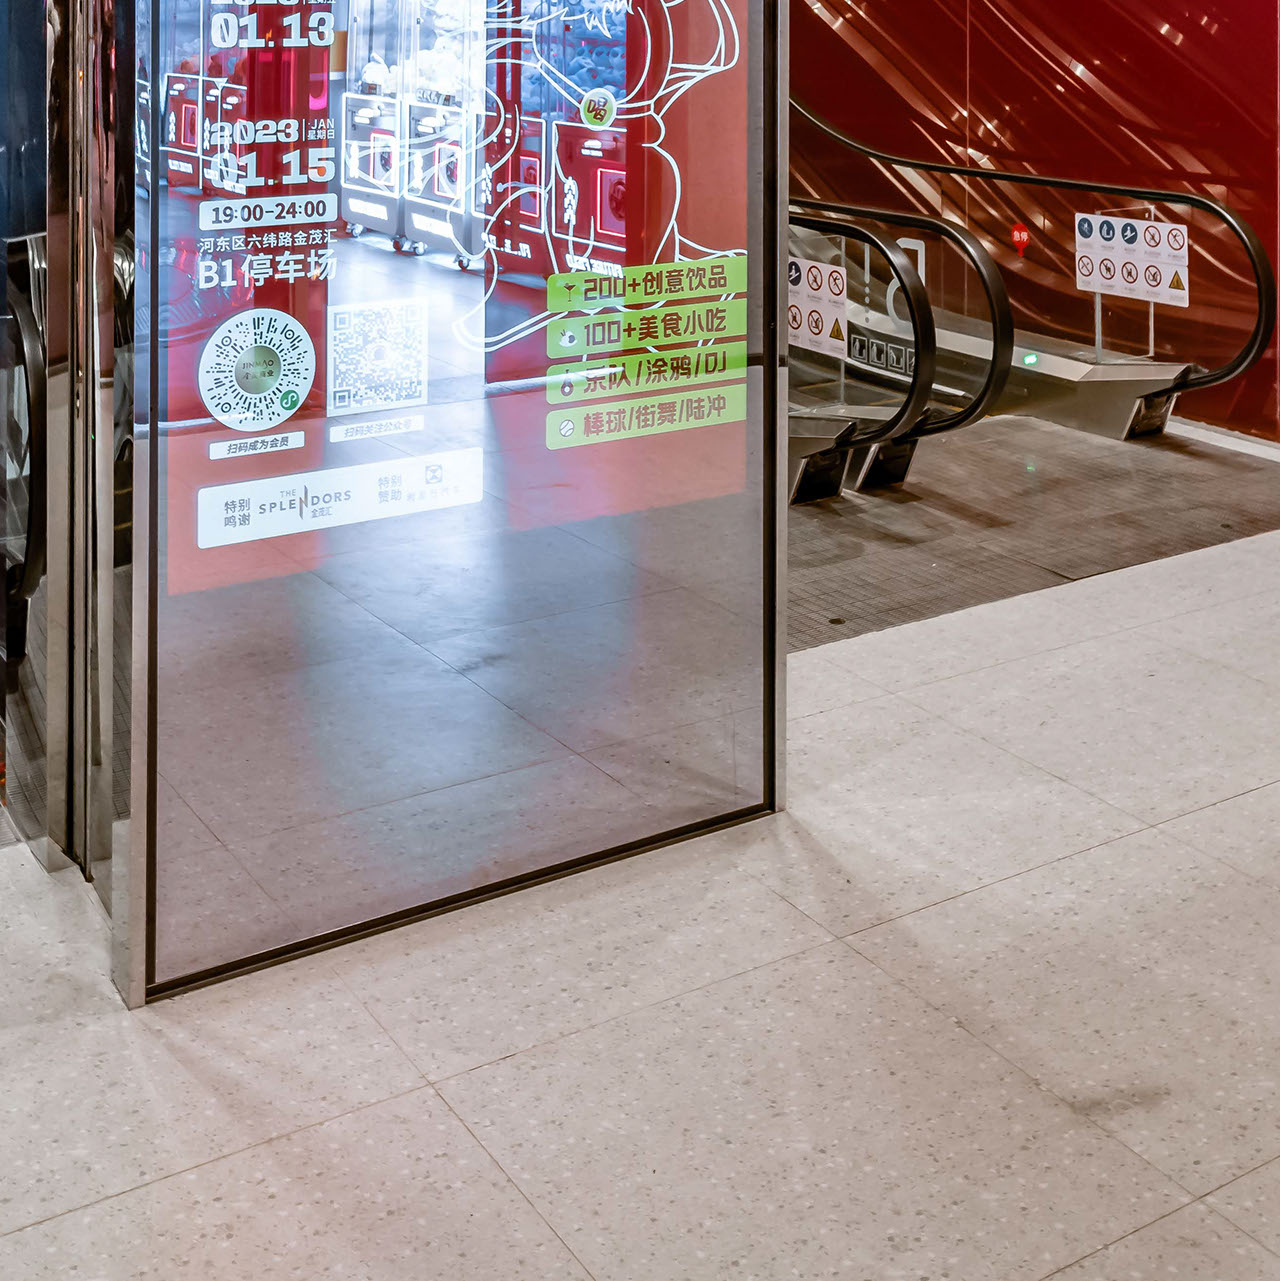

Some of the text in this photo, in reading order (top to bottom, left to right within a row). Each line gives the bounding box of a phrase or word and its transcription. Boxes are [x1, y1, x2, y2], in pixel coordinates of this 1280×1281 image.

[210, 11, 335, 48] 01.13
[210, 118, 300, 146] 2023
[307, 129, 336, 141] 星期日
[210, 147, 336, 189] 01.15
[197, 228, 338, 254] 河东区六纬路金茂汇
[198, 248, 338, 290] B1停车场
[583, 264, 728, 302] 200+创意饮品
[583, 307, 728, 348] 100+美食小吃
[583, 394, 727, 438] 棒球/街舞/陆冲
[226, 436, 290, 455] 扫码成为会员
[224, 497, 251, 514] 特别
[258, 485, 352, 520] SPLENDORS
[279, 489, 297, 498] THE
[224, 513, 251, 528] 鸣谢
